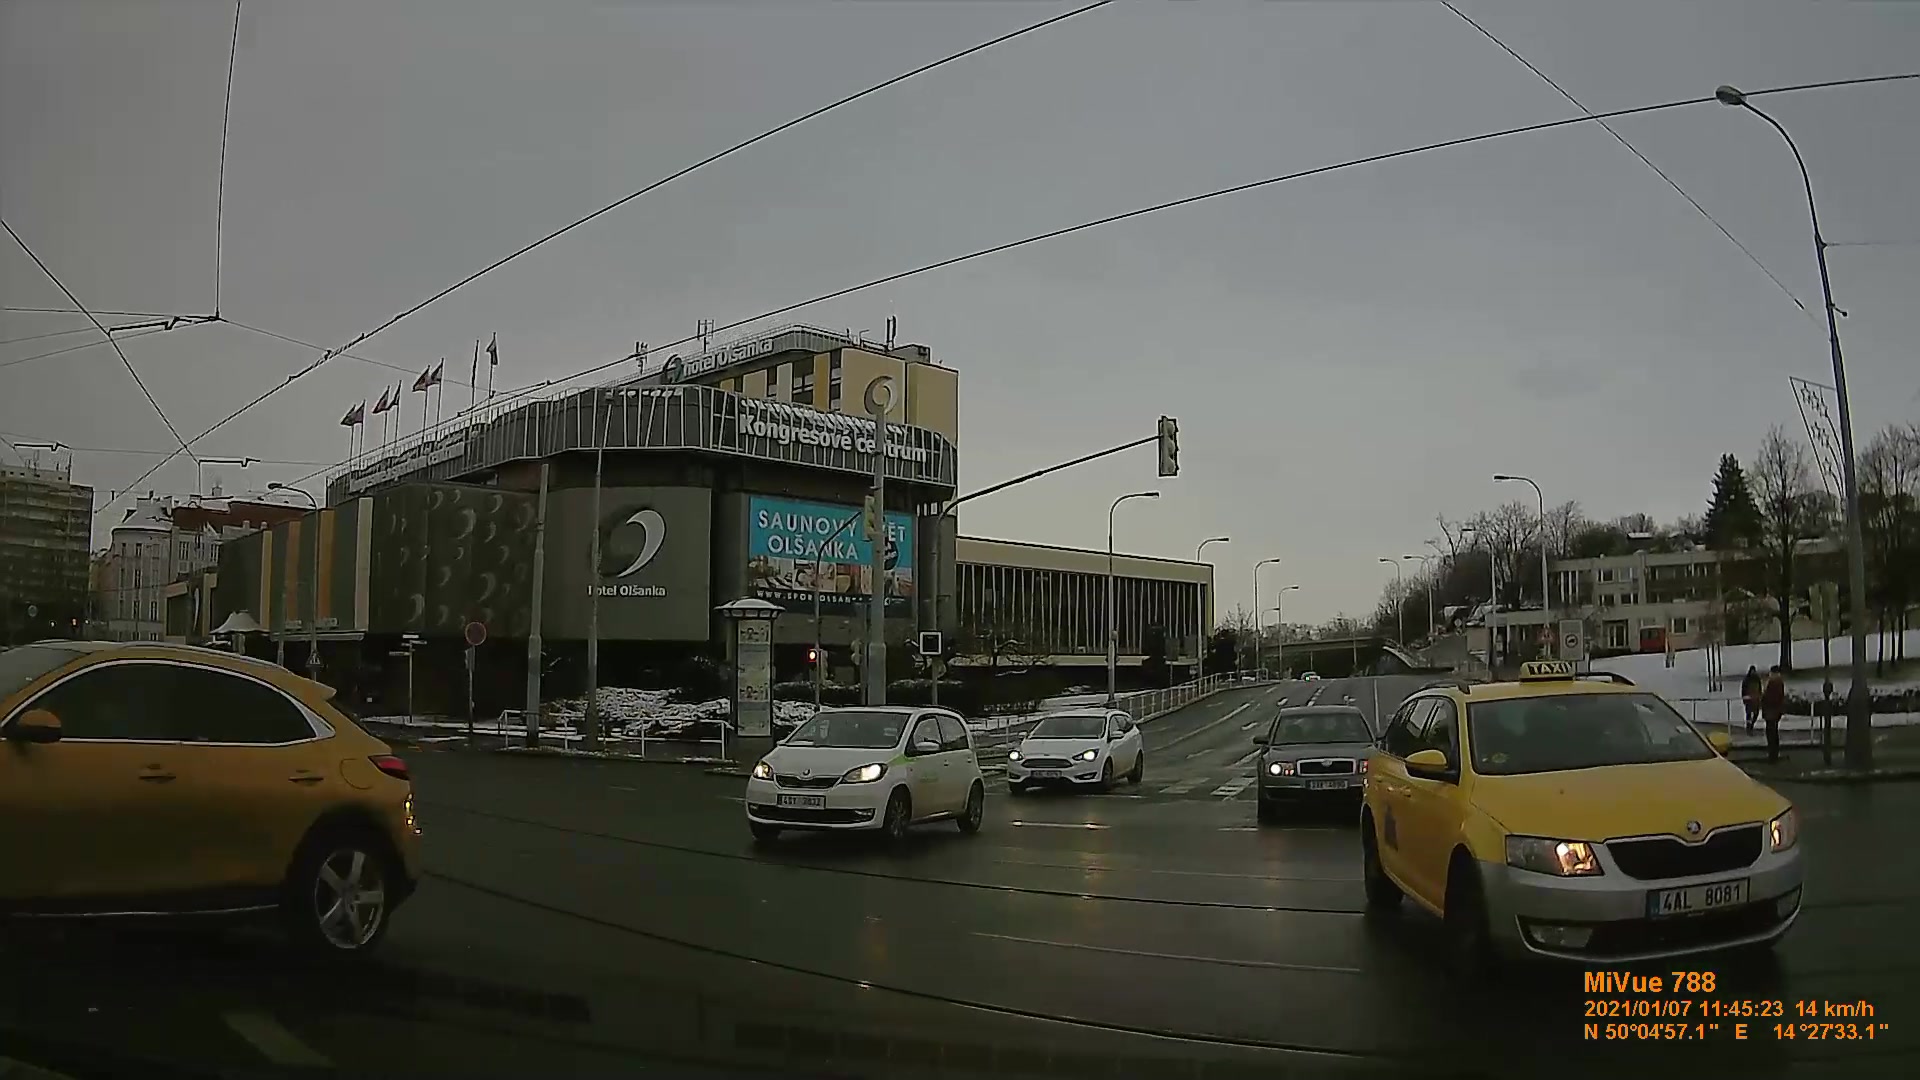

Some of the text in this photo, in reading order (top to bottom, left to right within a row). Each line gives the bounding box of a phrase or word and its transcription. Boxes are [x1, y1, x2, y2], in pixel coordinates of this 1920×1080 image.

[740, 414, 852, 450] Kongresové
[768, 534, 859, 561] OLŠANKA
[619, 584, 666, 596] Olšanka
[1529, 662, 1568, 675] TAXI
[1663, 885, 1741, 911] 4AL 8081
